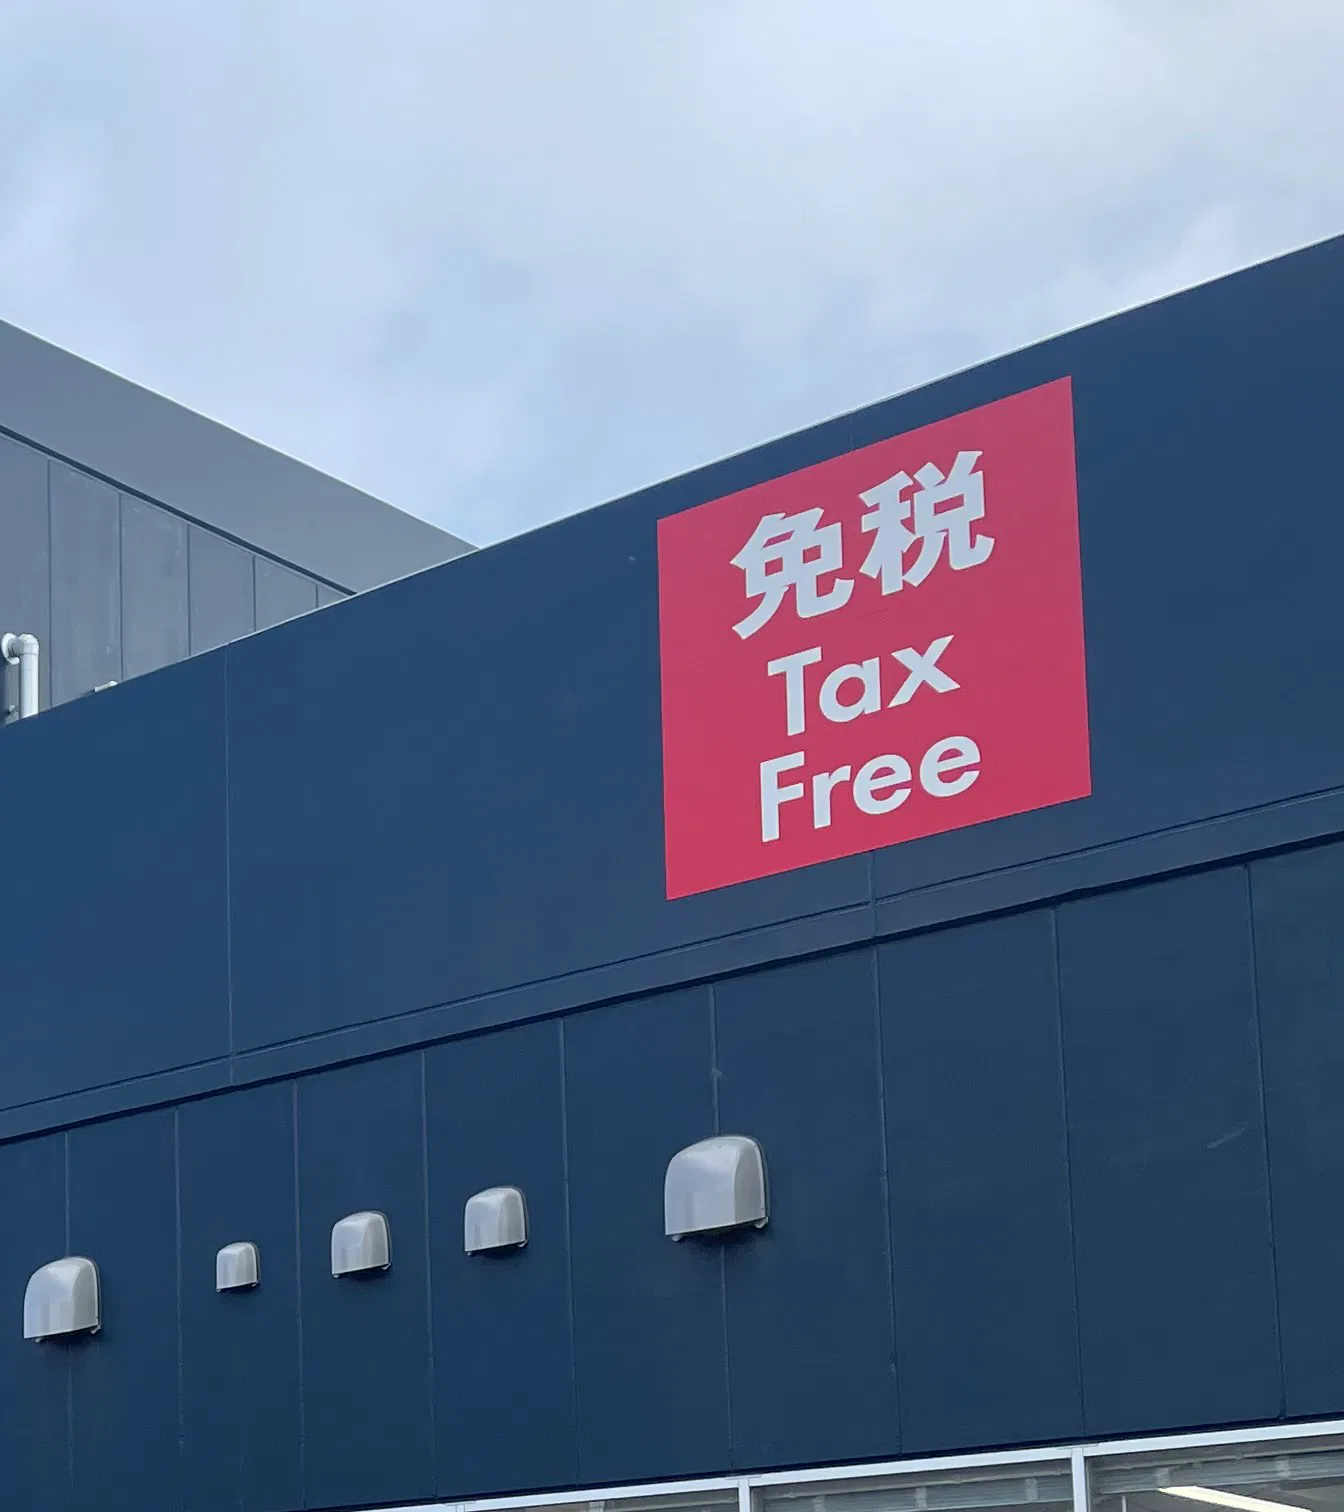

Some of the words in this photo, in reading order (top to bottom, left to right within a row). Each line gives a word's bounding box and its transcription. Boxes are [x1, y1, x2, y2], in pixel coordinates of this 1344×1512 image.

[729, 450, 995, 640] 免税
[767, 634, 961, 736] Tax
[760, 735, 981, 844] Free
